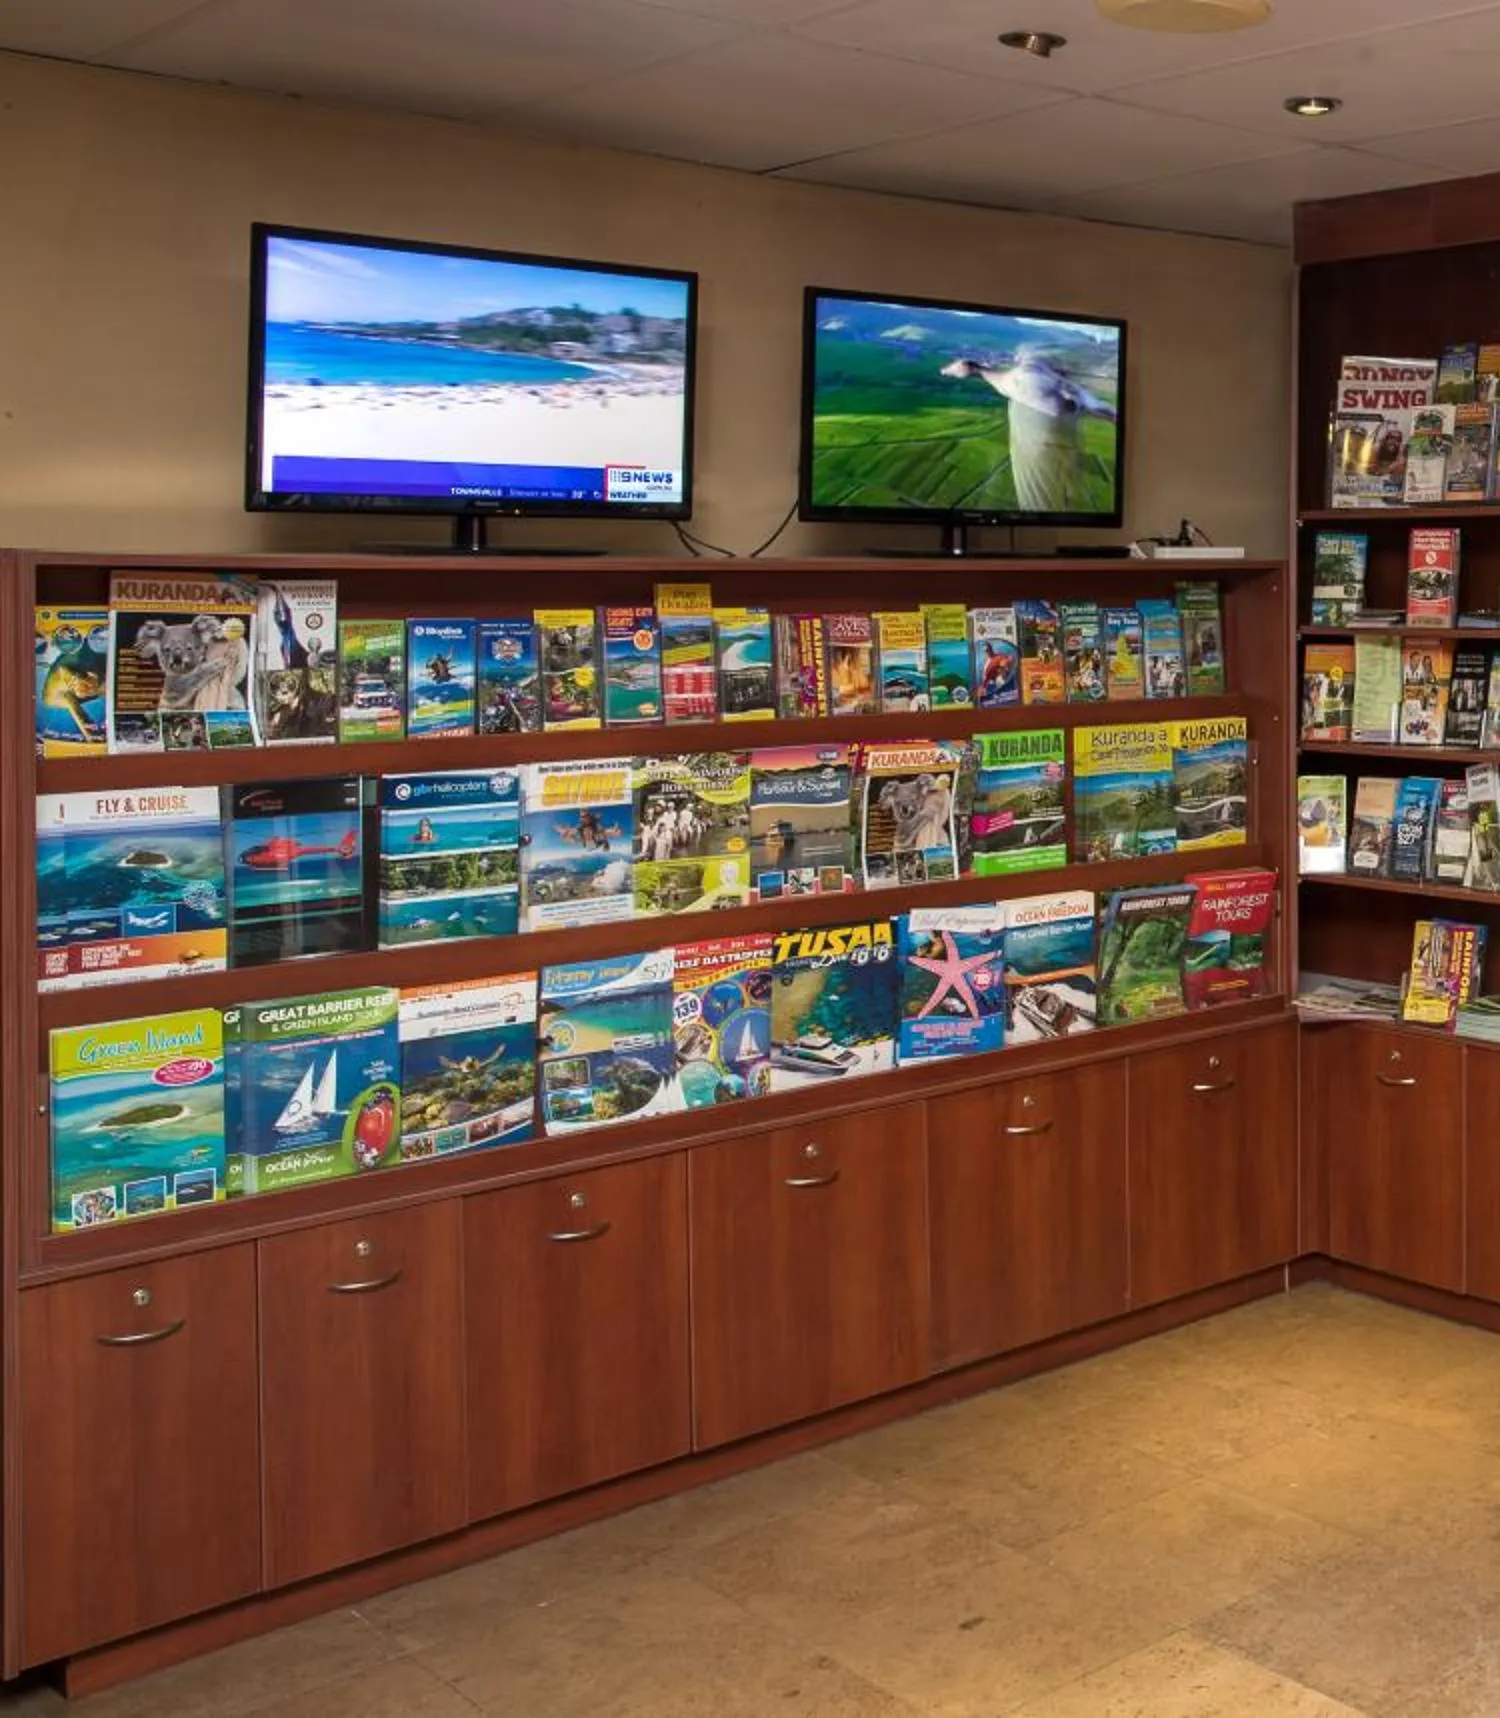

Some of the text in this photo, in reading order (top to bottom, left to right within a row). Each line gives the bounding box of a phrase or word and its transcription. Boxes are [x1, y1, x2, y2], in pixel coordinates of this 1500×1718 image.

[1343, 389, 1427, 409] SWING
[116, 581, 219, 601] KURANDA
[1091, 730, 1155, 748] Kuranda
[1179, 724, 1246, 742] KURANDA
[988, 733, 1062, 758] KURANDA
[96, 795, 189, 814] FLY & CRUISE
[1201, 893, 1269, 911] RAINFOREST
[1015, 903, 1090, 924] OCEAN FREEDOM
[1215, 907, 1252, 922] TOURS
[1075, 920, 1093, 931] Reef
[258, 1005, 307, 1024] GREAT
[307, 999, 363, 1020] BARRIER
[364, 993, 395, 1011] REEF
[675, 999, 699, 1019] 139
[282, 1018, 316, 1032] GREEN
[317, 1013, 353, 1027] ISLAND
[79, 1024, 205, 1063] Green Island
[265, 1158, 302, 1174] OCEAN
